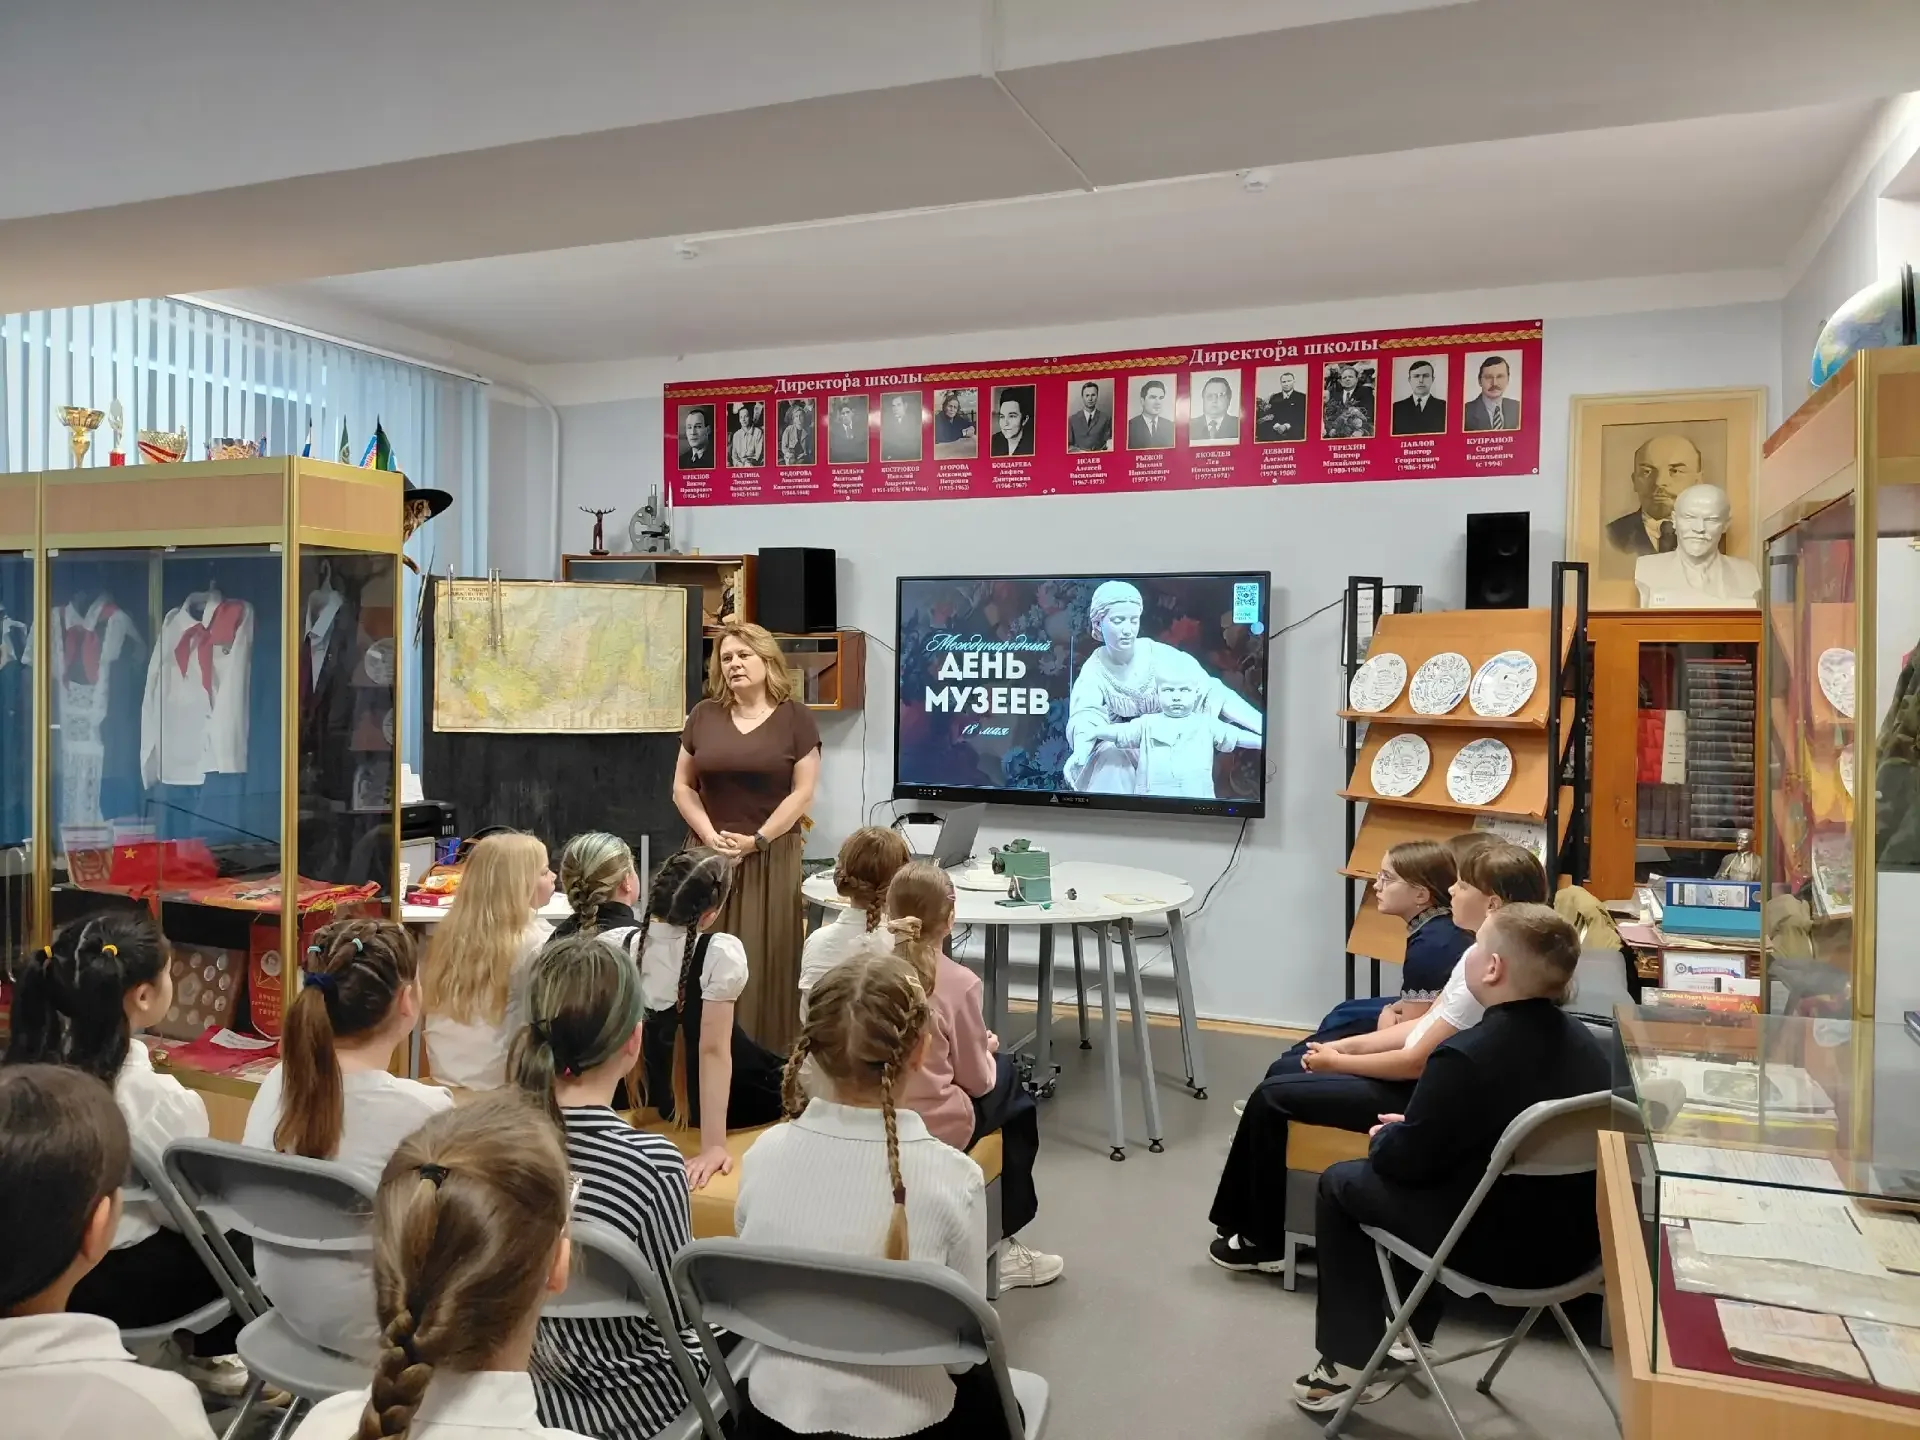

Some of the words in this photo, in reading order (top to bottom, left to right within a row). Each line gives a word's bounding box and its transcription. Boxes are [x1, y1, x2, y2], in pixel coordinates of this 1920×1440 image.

[1189, 345, 1298, 367] Директора
[1304, 338, 1379, 357] школы
[774, 375, 860, 394] Директора
[864, 372, 923, 388] школы
[1401, 440, 1435, 448] ПАВЛОВ
[1476, 445, 1504, 453] Сергей
[1195, 451, 1231, 459] ЯКОВЛЕВ
[1395, 456, 1440, 464] Георгиевич
[1466, 453, 1514, 461] Васильевич
[925, 634, 1051, 654] Международный
[938, 652, 1026, 681] ДЕНЬ
[925, 686, 1050, 715] МУЗЕЕВ
[962, 724, 978, 736] 18
[979, 726, 1009, 736] мая
